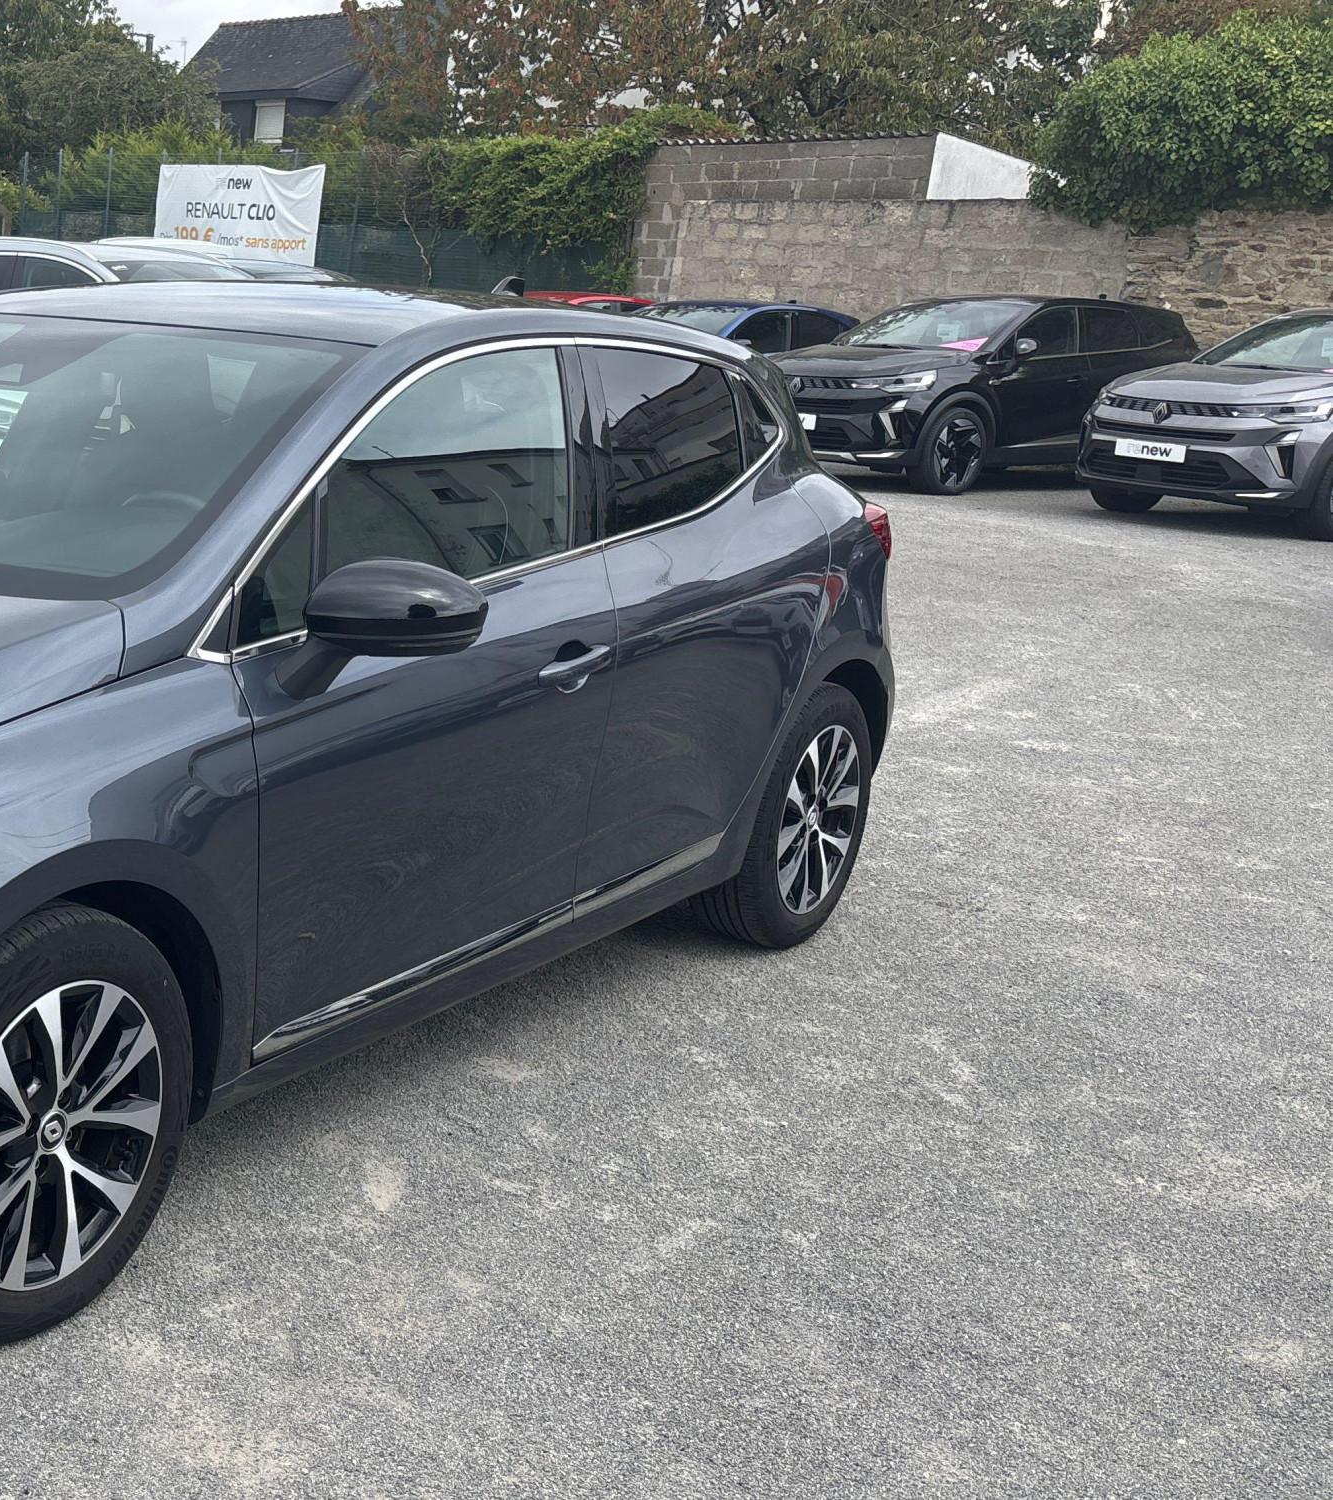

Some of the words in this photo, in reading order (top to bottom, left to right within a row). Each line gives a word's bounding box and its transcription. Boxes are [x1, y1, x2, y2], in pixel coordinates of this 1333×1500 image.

[186, 202, 246, 220] RENAULT
[247, 203, 276, 221] CLIO
[244, 237, 269, 249] sans
[270, 237, 307, 253] apport
[1127, 443, 1172, 458] renew
